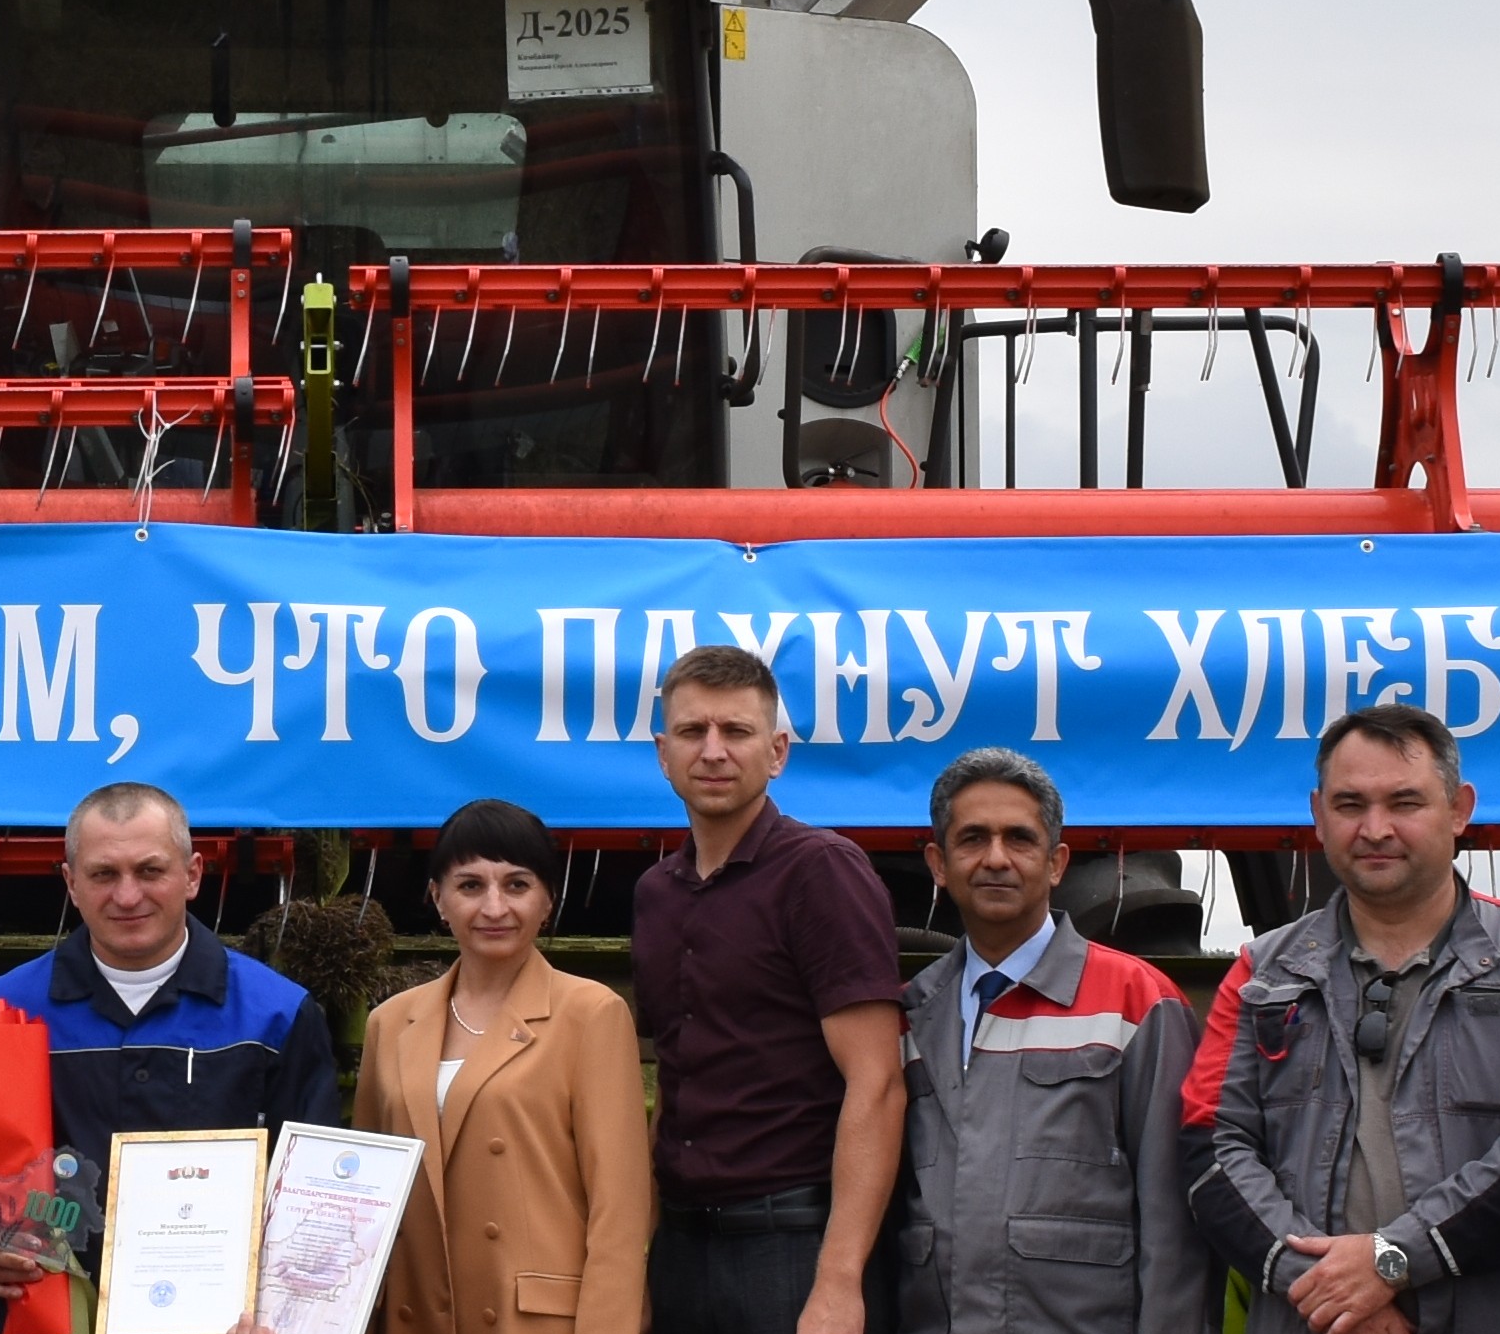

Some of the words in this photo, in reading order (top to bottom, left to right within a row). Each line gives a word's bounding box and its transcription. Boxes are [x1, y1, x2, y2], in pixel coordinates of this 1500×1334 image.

[516, 6, 630, 46] Д-2025
[192, 603, 489, 743] ЧТО
[24, 1189, 81, 1232] 1000
